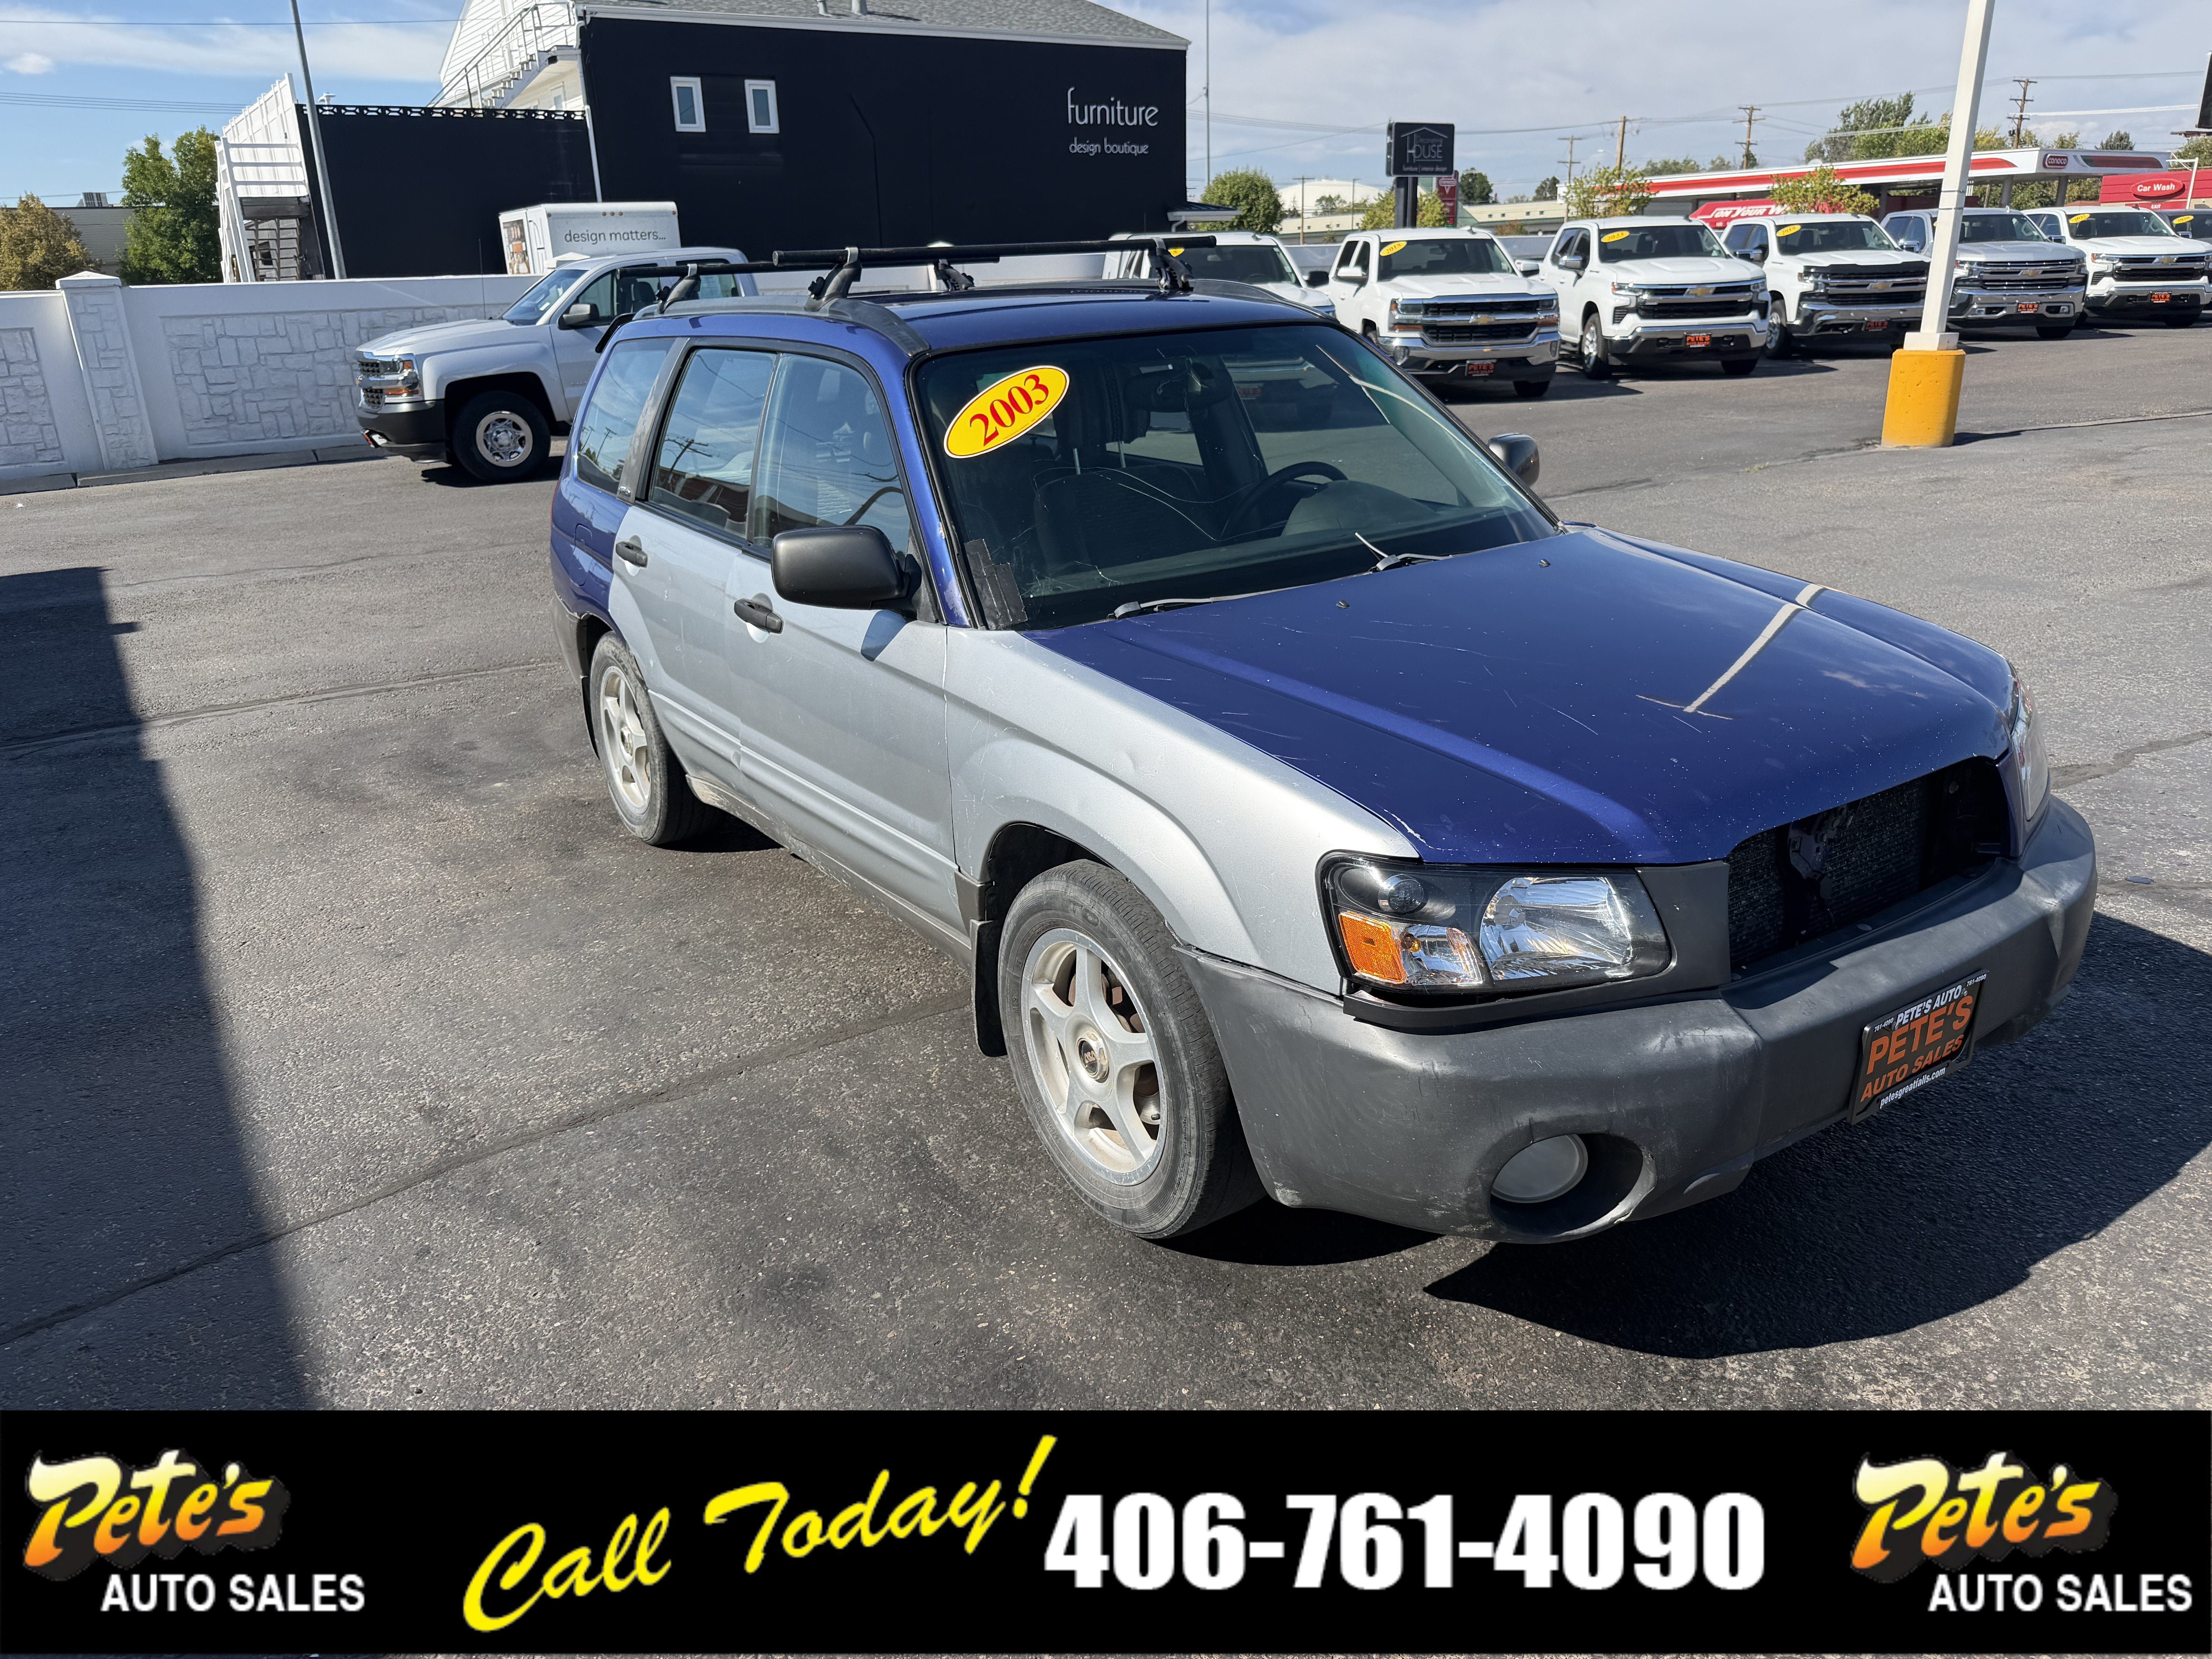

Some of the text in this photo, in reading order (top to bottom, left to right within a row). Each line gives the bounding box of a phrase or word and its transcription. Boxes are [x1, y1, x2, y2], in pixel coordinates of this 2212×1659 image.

[1067, 86, 1159, 127] furniture
[1069, 136, 1149, 156] design boutique
[1407, 134, 1443, 163] HOUSE
[2153, 183, 2176, 191] Wash
[564, 229, 666, 245] design matters...
[970, 374, 1049, 447] 2003
[1966, 974, 1987, 987] 761-4090
[1895, 985, 1962, 1027] PETE'S AUTO
[1867, 995, 1973, 1075] PETE'S
[1874, 1017, 1894, 1032] 761-4090
[1860, 1034, 1964, 1103] AUTO SALES
[1880, 1066, 1946, 1109] petesgreatfalls.com
